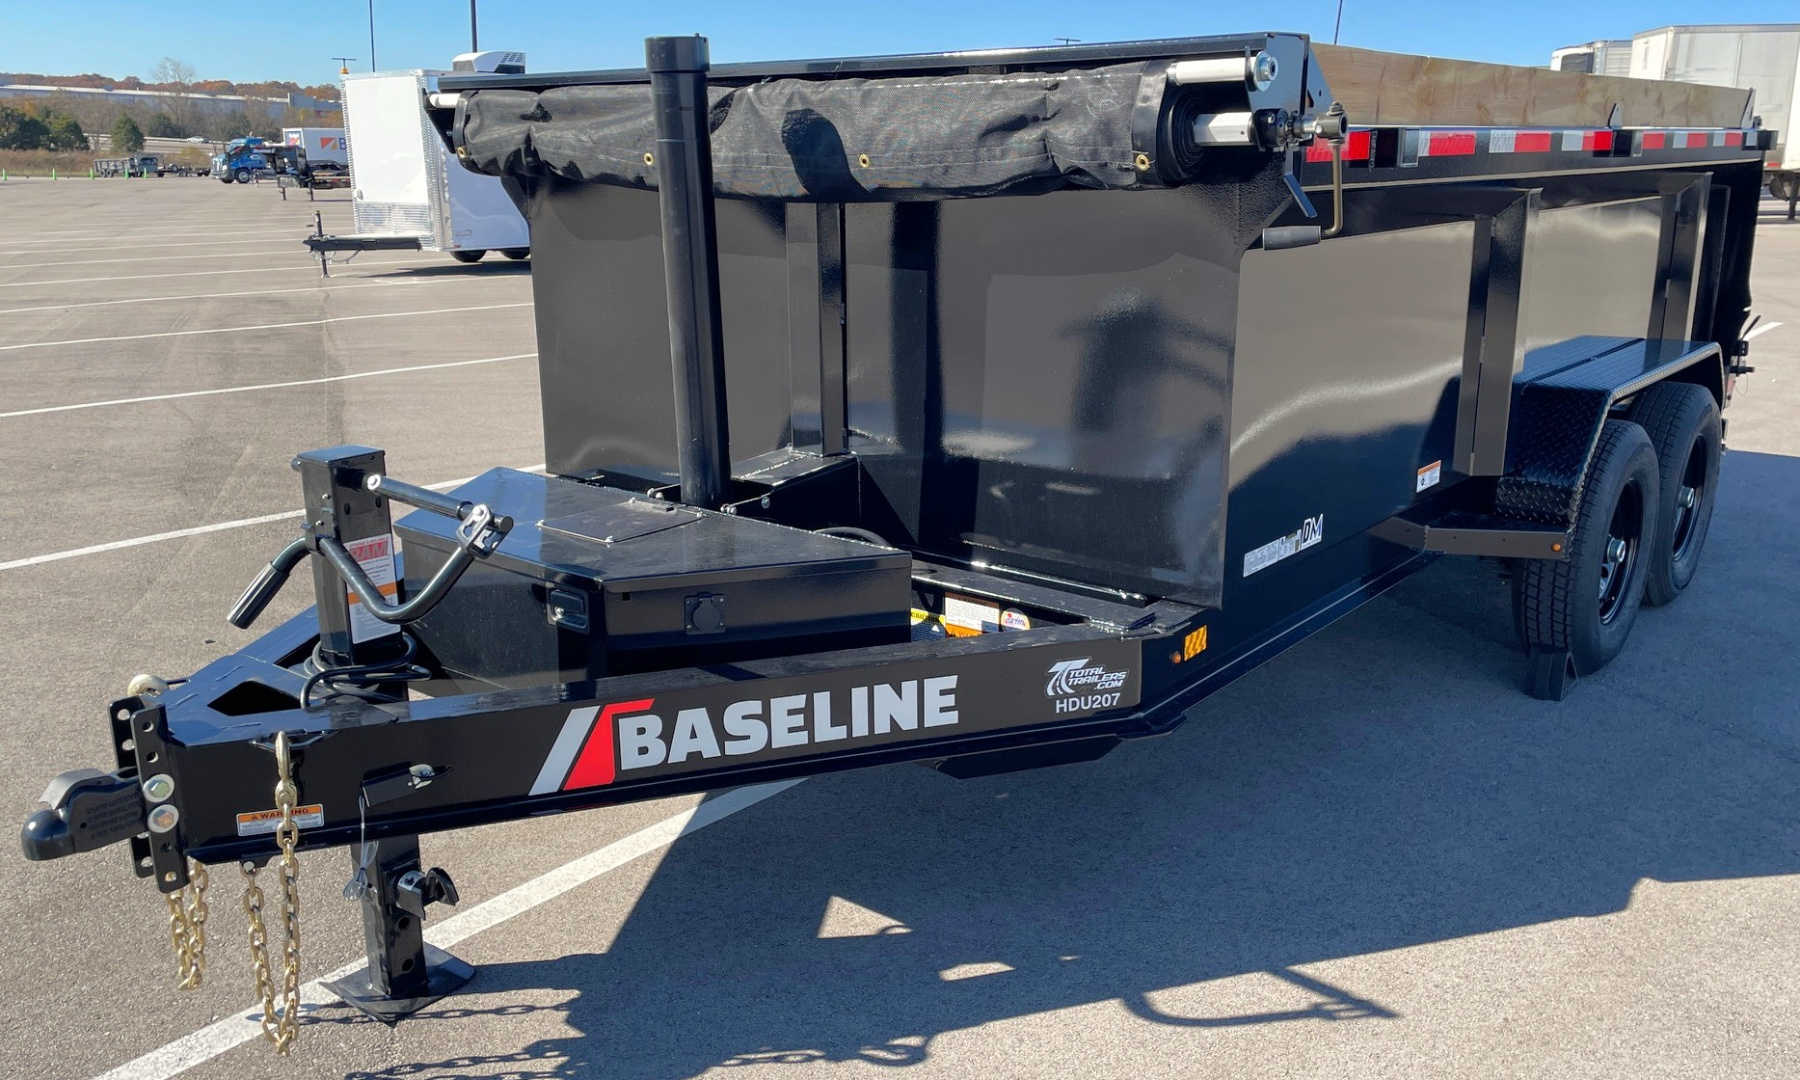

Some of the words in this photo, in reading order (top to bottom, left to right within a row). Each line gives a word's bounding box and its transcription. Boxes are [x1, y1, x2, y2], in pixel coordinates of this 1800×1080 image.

[1068, 671, 1127, 686] TRAILERS
[1069, 666, 1106, 678] TOTAL
[1093, 680, 1124, 690] .COM
[1056, 692, 1121, 714] HDU207
[617, 674, 959, 771] BASELINE
[260, 808, 309, 820] WARING
